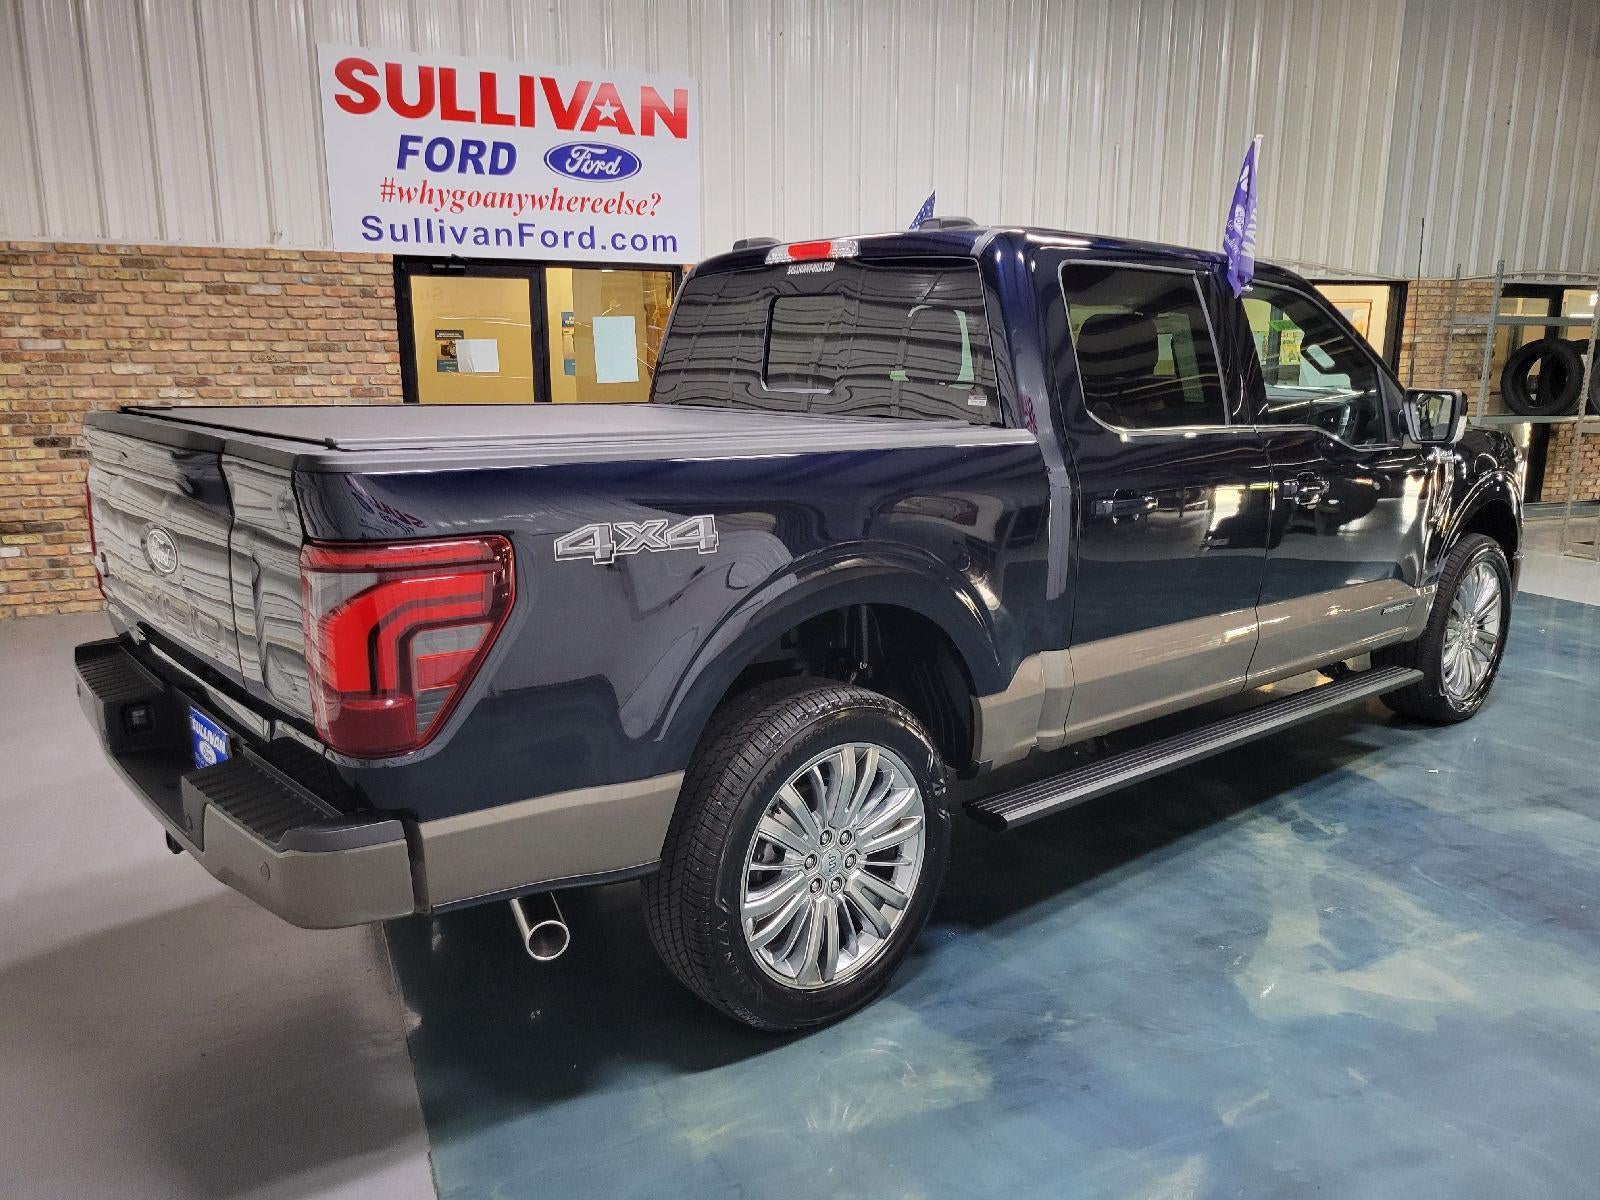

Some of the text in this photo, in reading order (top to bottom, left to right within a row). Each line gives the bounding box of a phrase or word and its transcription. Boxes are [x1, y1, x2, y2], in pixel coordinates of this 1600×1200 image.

[334, 57, 688, 139] SULLIVAN
[396, 134, 623, 177] FORD Ford
[379, 176, 662, 217] #whygoanywhereelse?
[361, 215, 678, 252] SullivanFord.com
